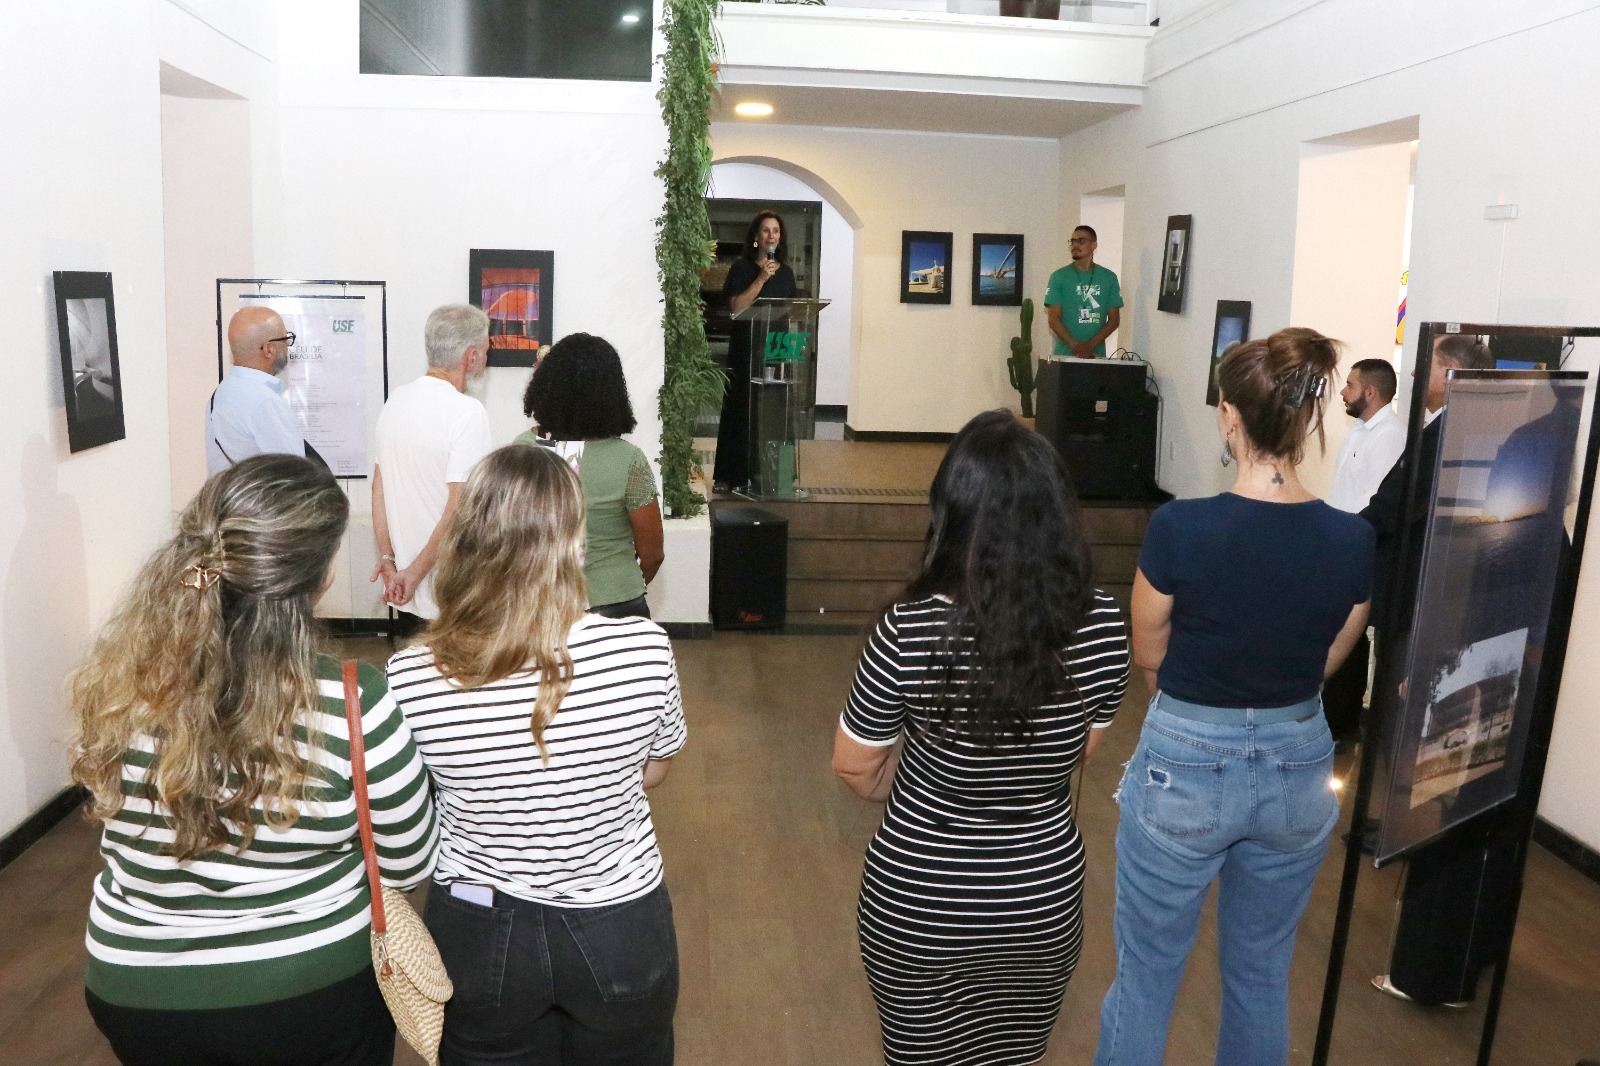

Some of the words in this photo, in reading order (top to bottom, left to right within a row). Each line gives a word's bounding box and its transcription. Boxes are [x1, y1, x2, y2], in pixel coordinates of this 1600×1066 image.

[332, 319, 355, 332] USF
[311, 345, 322, 353] DE
[765, 331, 811, 358] USF
